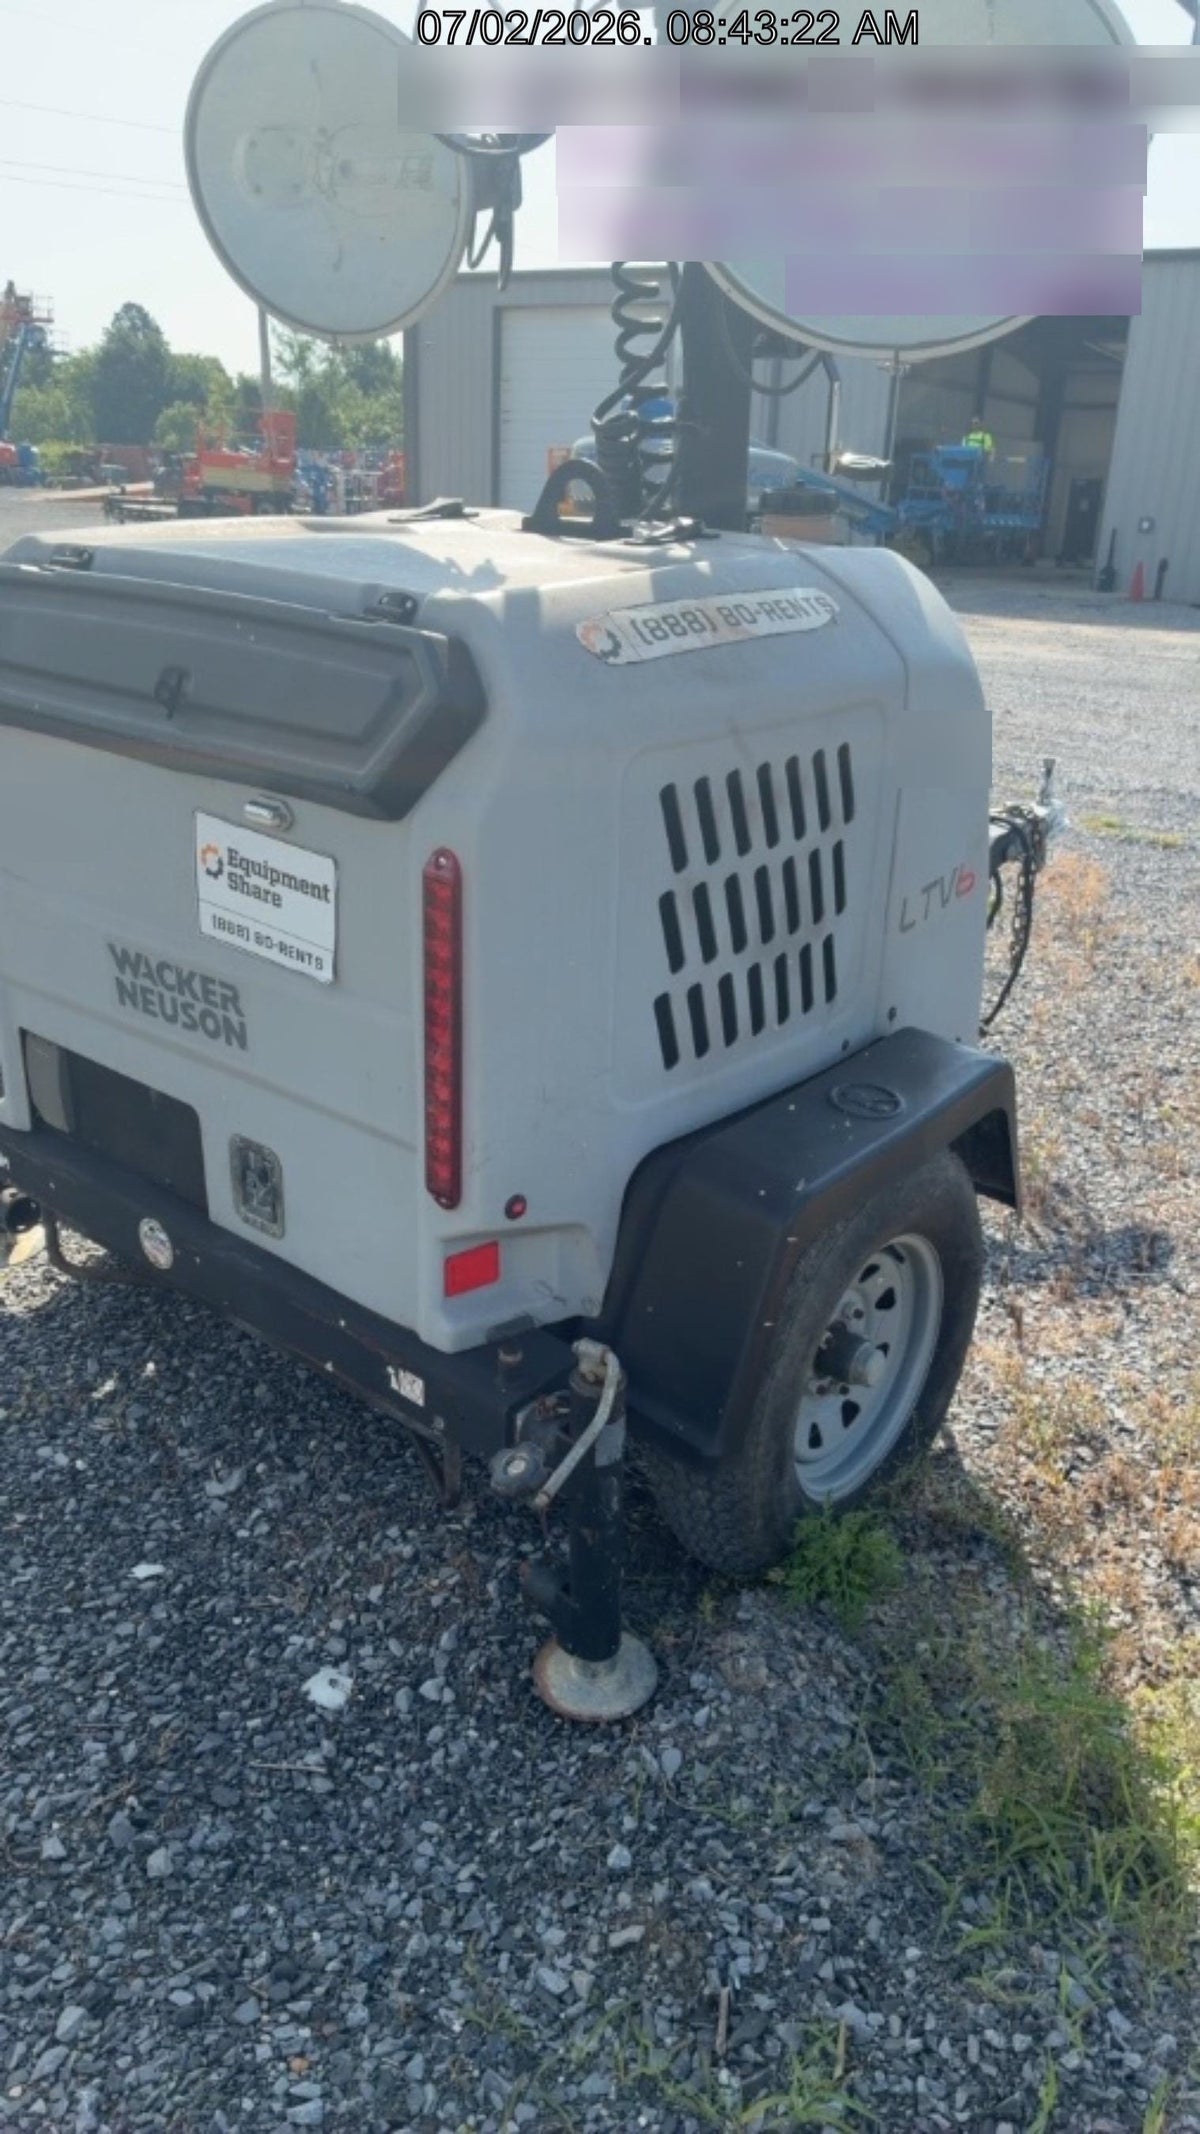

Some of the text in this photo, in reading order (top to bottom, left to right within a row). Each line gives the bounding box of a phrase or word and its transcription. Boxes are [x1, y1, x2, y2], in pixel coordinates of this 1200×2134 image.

[631, 608, 717, 646] (888)
[227, 847, 330, 904] Equipment
[227, 872, 282, 908] Share
[899, 862, 976, 933] LTV6
[107, 943, 245, 1018] WACKER
[115, 977, 247, 1050] NEUSON
